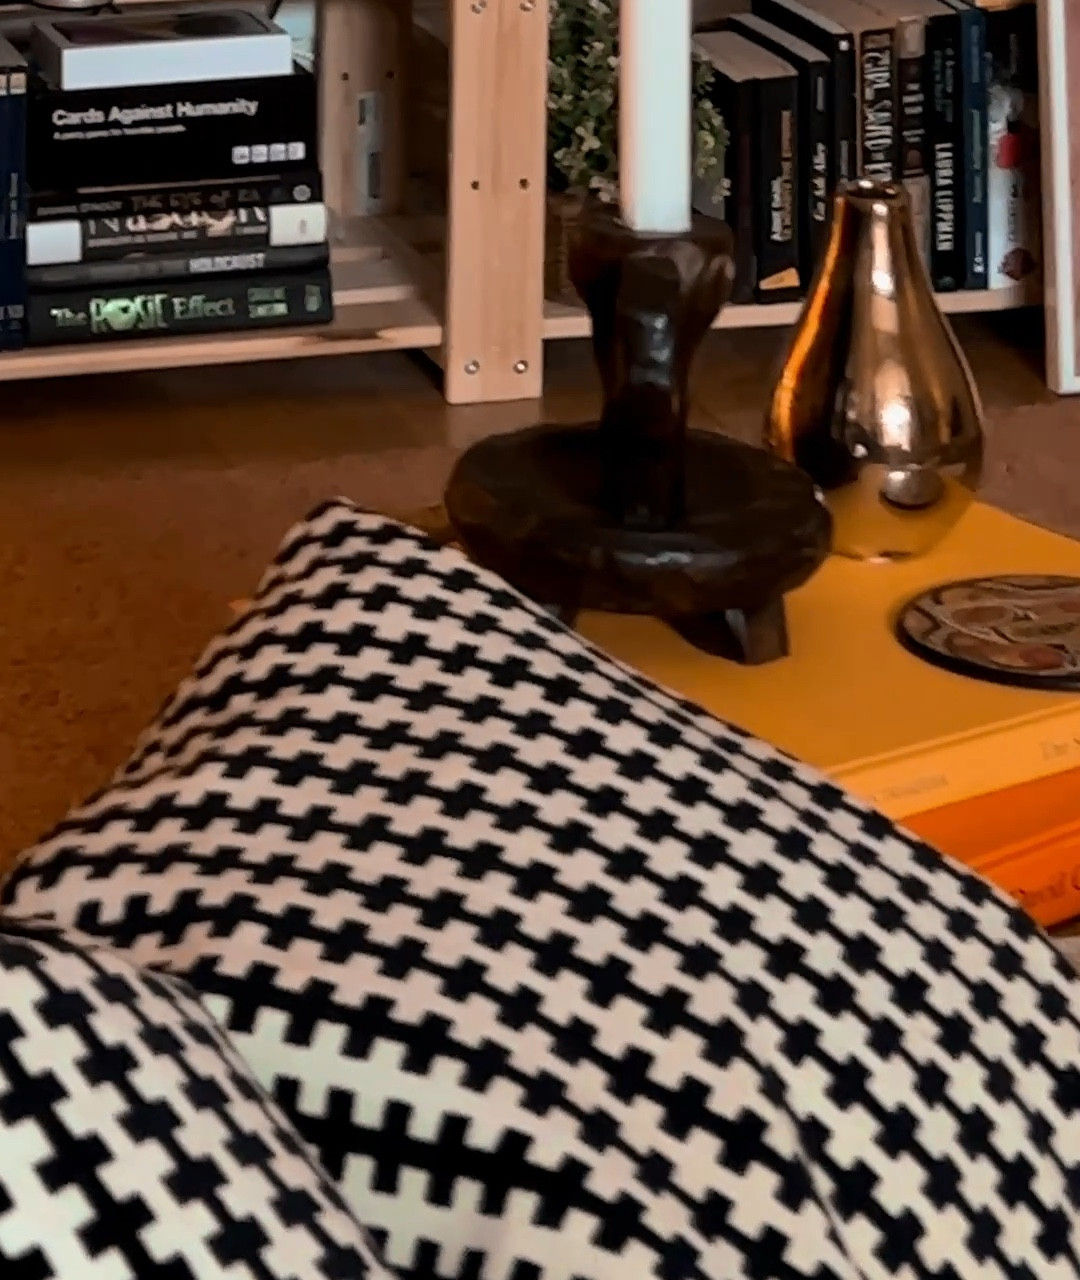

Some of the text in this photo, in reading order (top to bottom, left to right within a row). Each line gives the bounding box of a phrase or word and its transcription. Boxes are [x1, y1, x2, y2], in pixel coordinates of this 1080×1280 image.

[51, 97, 260, 126] Cards Against Humanity
[935, 142, 955, 252] LAURA LIPPMAN
[171, 294, 237, 320] Effect
